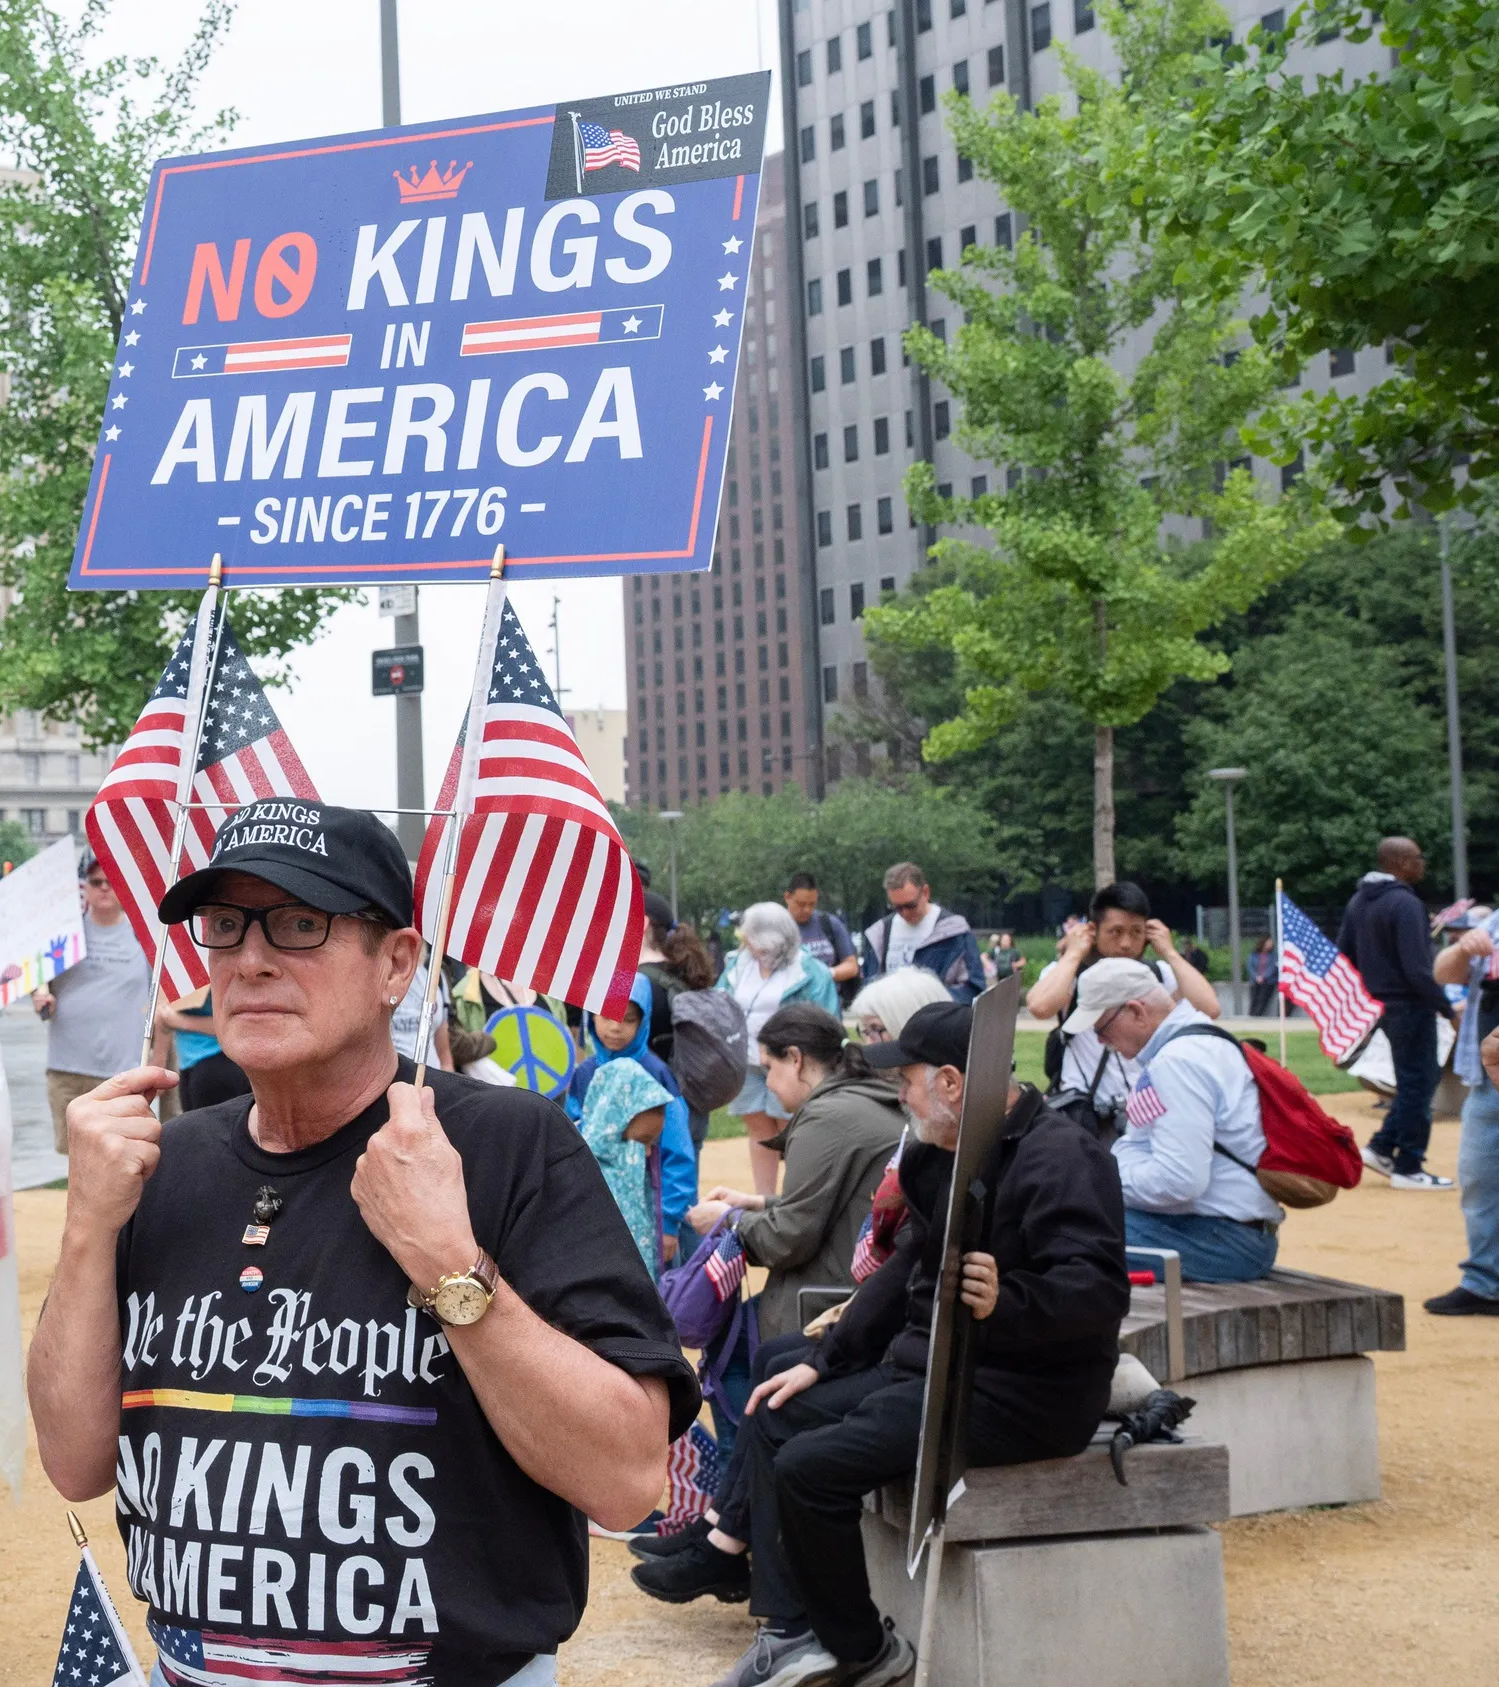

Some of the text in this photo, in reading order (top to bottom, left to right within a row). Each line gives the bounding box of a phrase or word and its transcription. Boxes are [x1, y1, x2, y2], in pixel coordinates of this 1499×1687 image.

[614, 83, 707, 107] UNITED WE STAND
[652, 100, 754, 138] God Bless
[654, 133, 741, 170] America
[182, 188, 676, 325] NO KINGS
[379, 320, 431, 370] IN
[150, 365, 644, 485] AMERICA
[249, 493, 392, 545] SINCE
[404, 486, 508, 540] 1776
[224, 824, 329, 857] AMERICA
[250, 803, 321, 825] KINGS
[171, 1290, 253, 1380] the
[253, 1288, 450, 1397] People
[116, 1431, 437, 1548] NO KINGS
[141, 1532, 440, 1635] AMERICA
